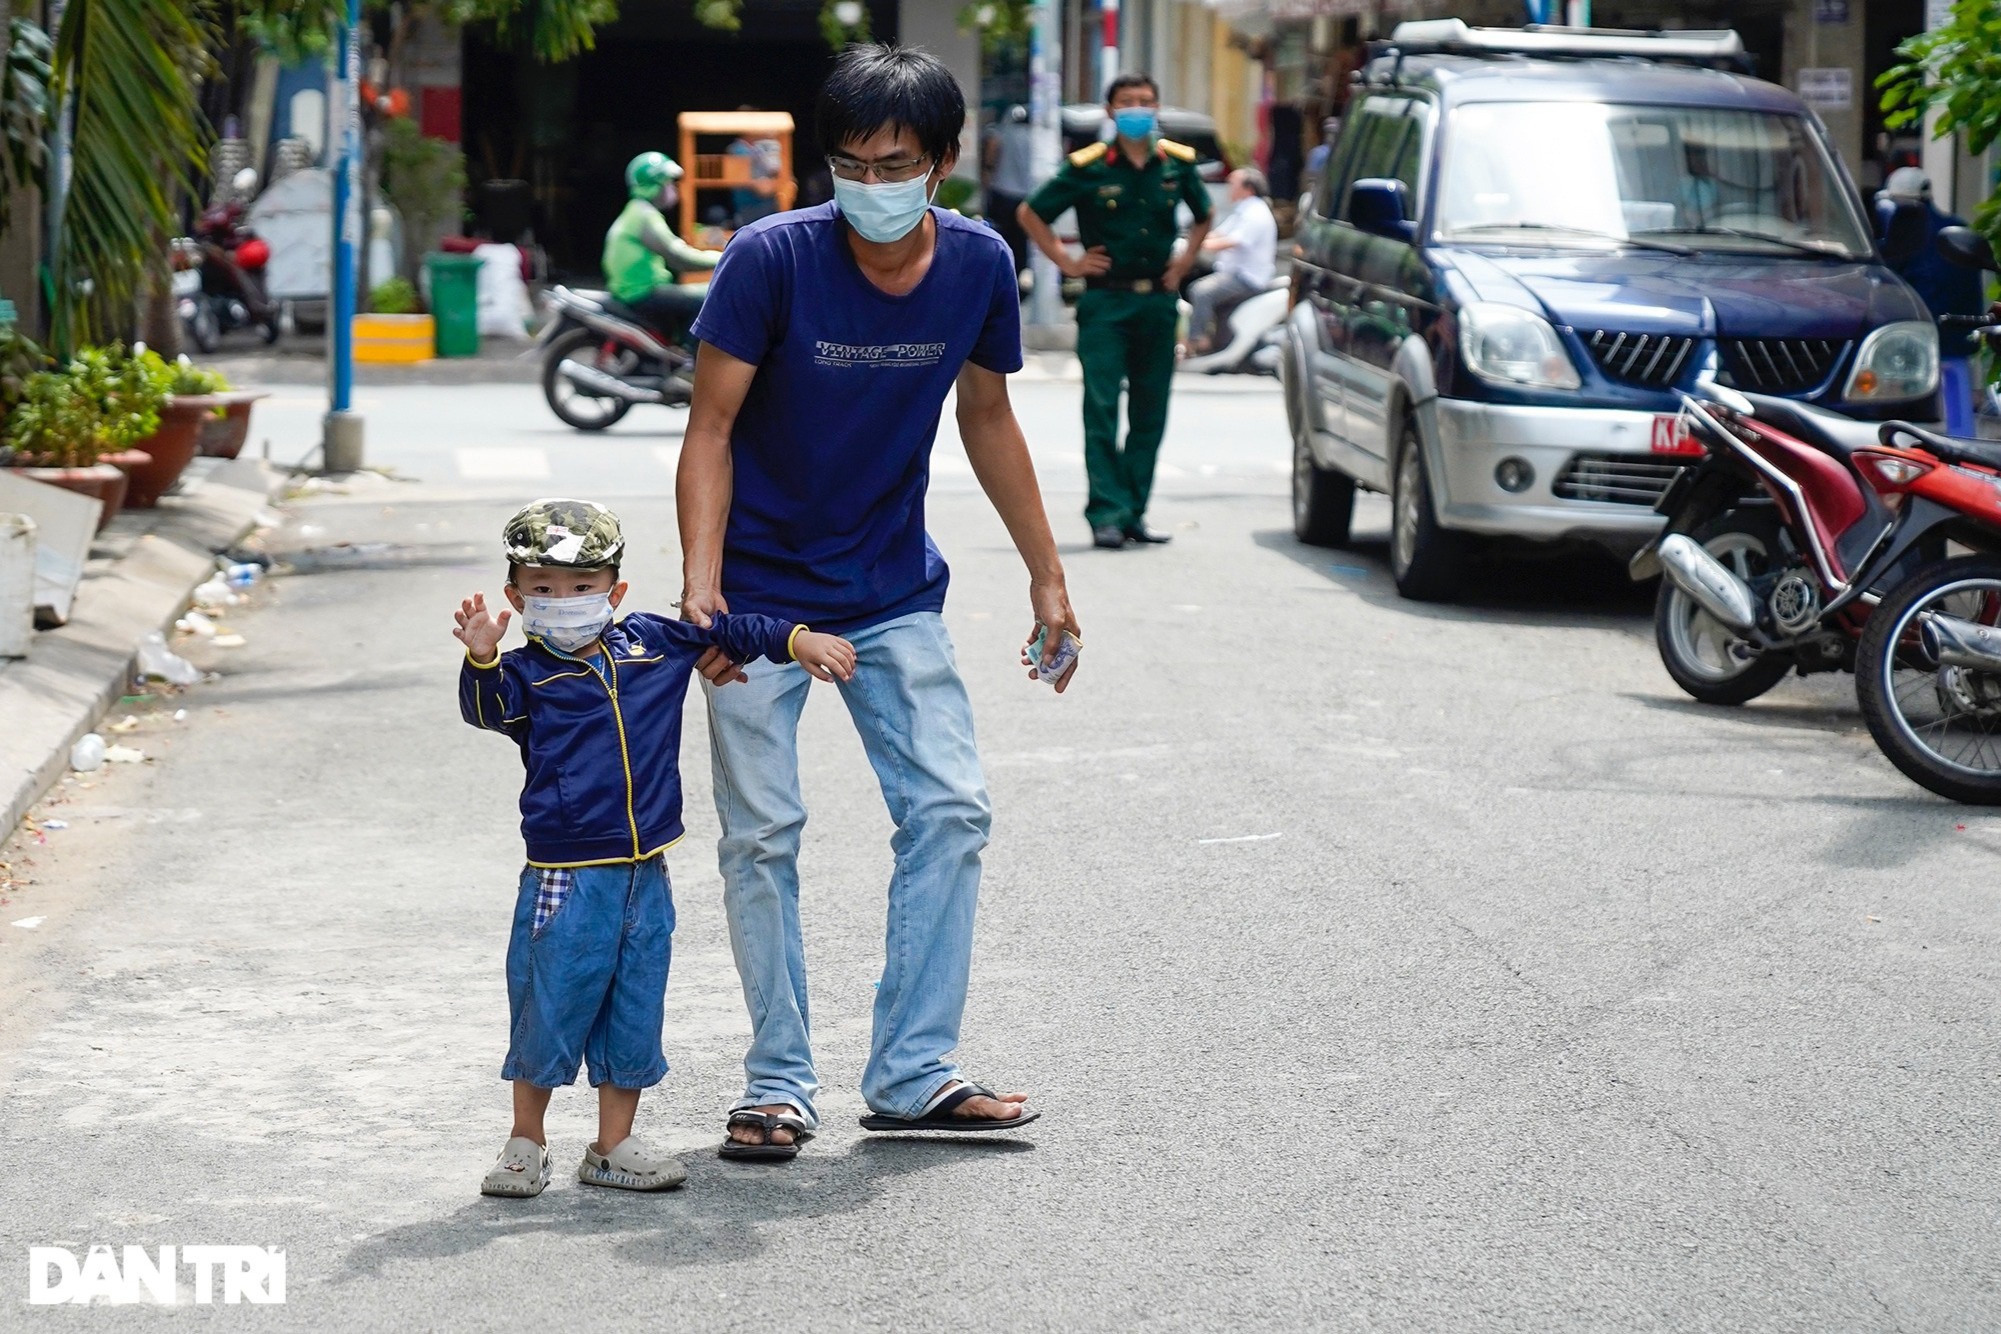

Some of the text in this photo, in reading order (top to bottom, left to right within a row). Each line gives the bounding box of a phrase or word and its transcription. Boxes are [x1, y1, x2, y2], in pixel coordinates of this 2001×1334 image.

[819, 342, 945, 359] VINTAGE POWER
[814, 358, 832, 366] LONG
